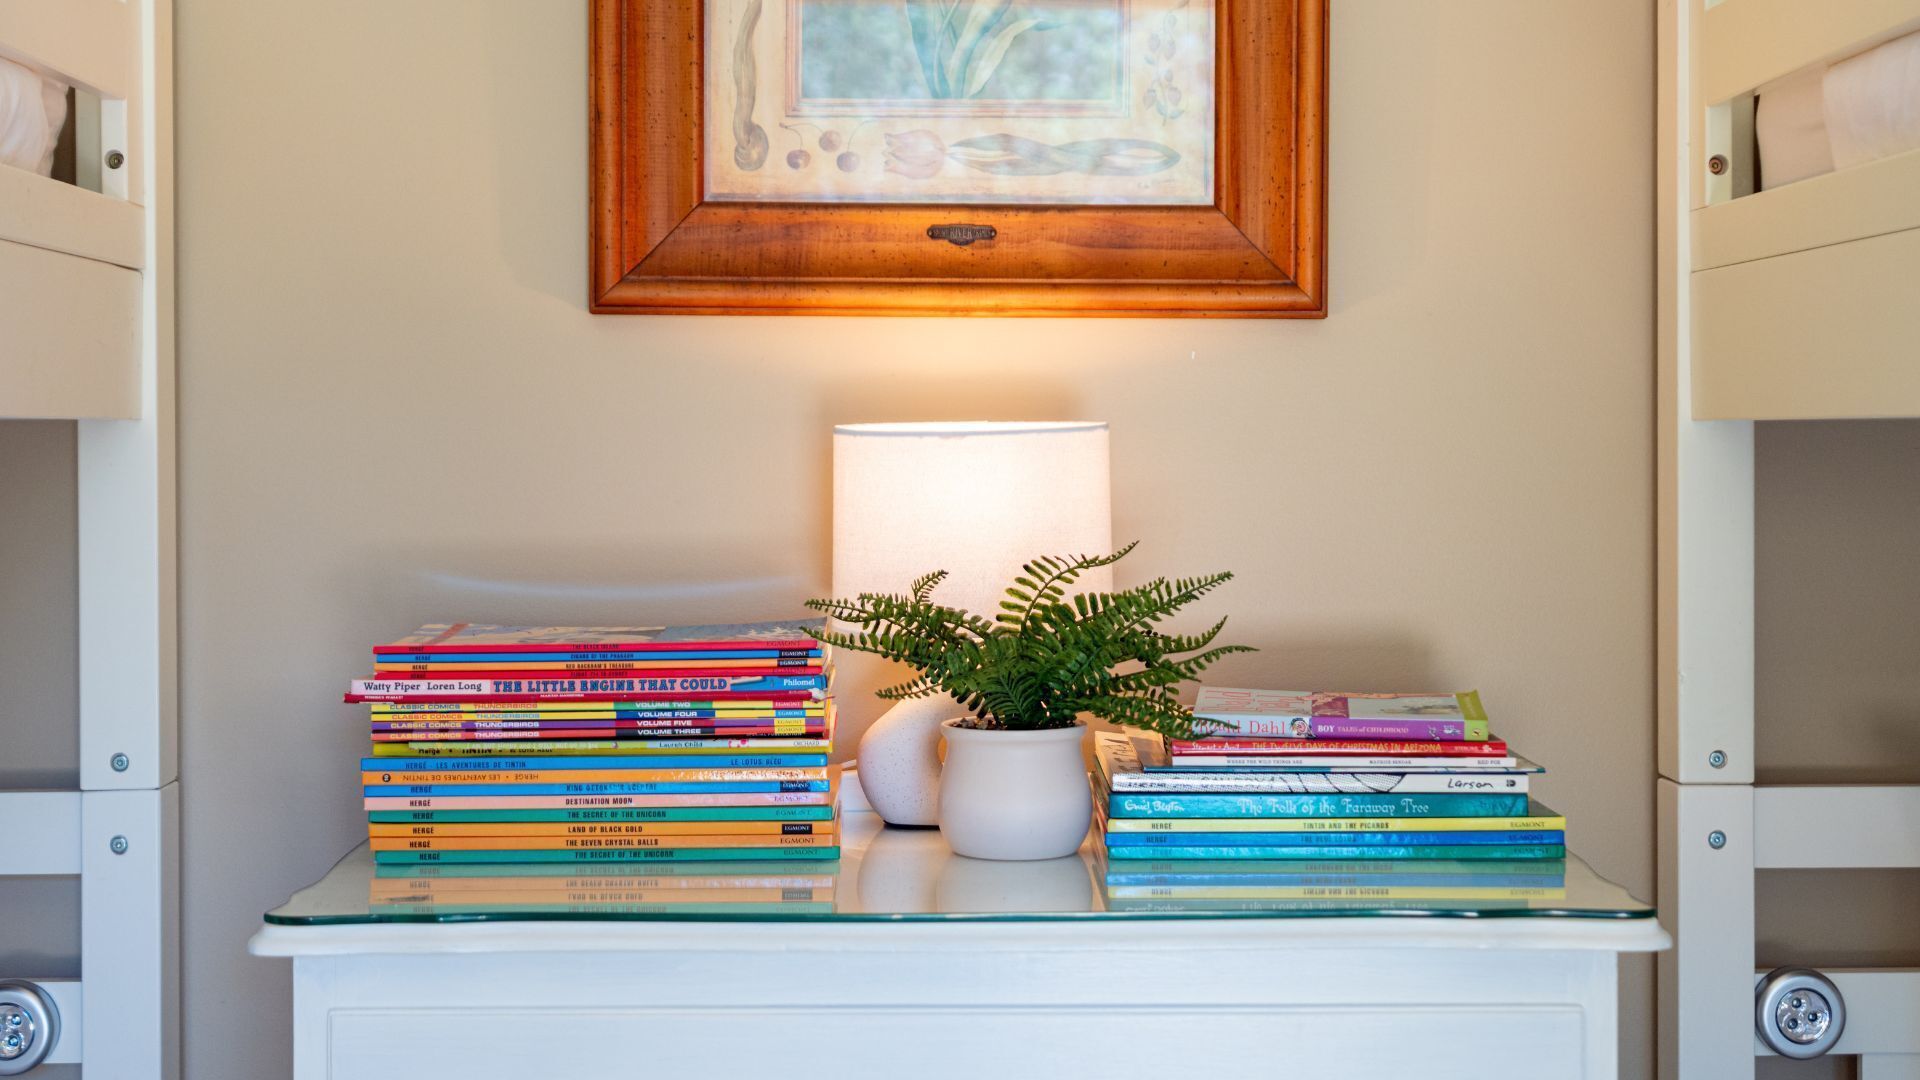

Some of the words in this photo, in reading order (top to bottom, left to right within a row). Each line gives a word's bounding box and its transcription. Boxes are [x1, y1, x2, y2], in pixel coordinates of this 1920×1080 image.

[494, 681, 522, 692] THE
[527, 680, 576, 692] LITTLE
[580, 680, 634, 691] ENGINE
[639, 679, 677, 691] THAT
[680, 678, 727, 690] COULD
[783, 678, 815, 686] Philomel
[363, 682, 391, 692] Watty
[394, 682, 421, 692] Piper
[427, 682, 455, 690] Loren
[458, 682, 482, 692] Long
[1249, 720, 1285, 735] Dahl
[1341, 743, 1389, 751] CHRISTMAS
[1390, 744, 1401, 752] IN
[1447, 778, 1494, 789] Larson
[410, 785, 432, 793] HERGÉ
[409, 799, 431, 807] HERGÉ
[1124, 799, 1151, 814] Enid
[1152, 800, 1185, 813] Blyton
[1237, 797, 1262, 816] The
[1267, 797, 1298, 815] Folk
[1301, 799, 1315, 815] of
[1319, 799, 1336, 816] the
[1341, 798, 1396, 816] Faraway
[1400, 798, 1430, 813] Tree
[412, 826, 434, 834] HERGÉ
[625, 825, 643, 833] GOLD
[409, 840, 431, 848] HERGÉ
[581, 839, 602, 847] SEVEN
[419, 852, 441, 860] HERGÉ
[644, 850, 674, 858] UNICORN
